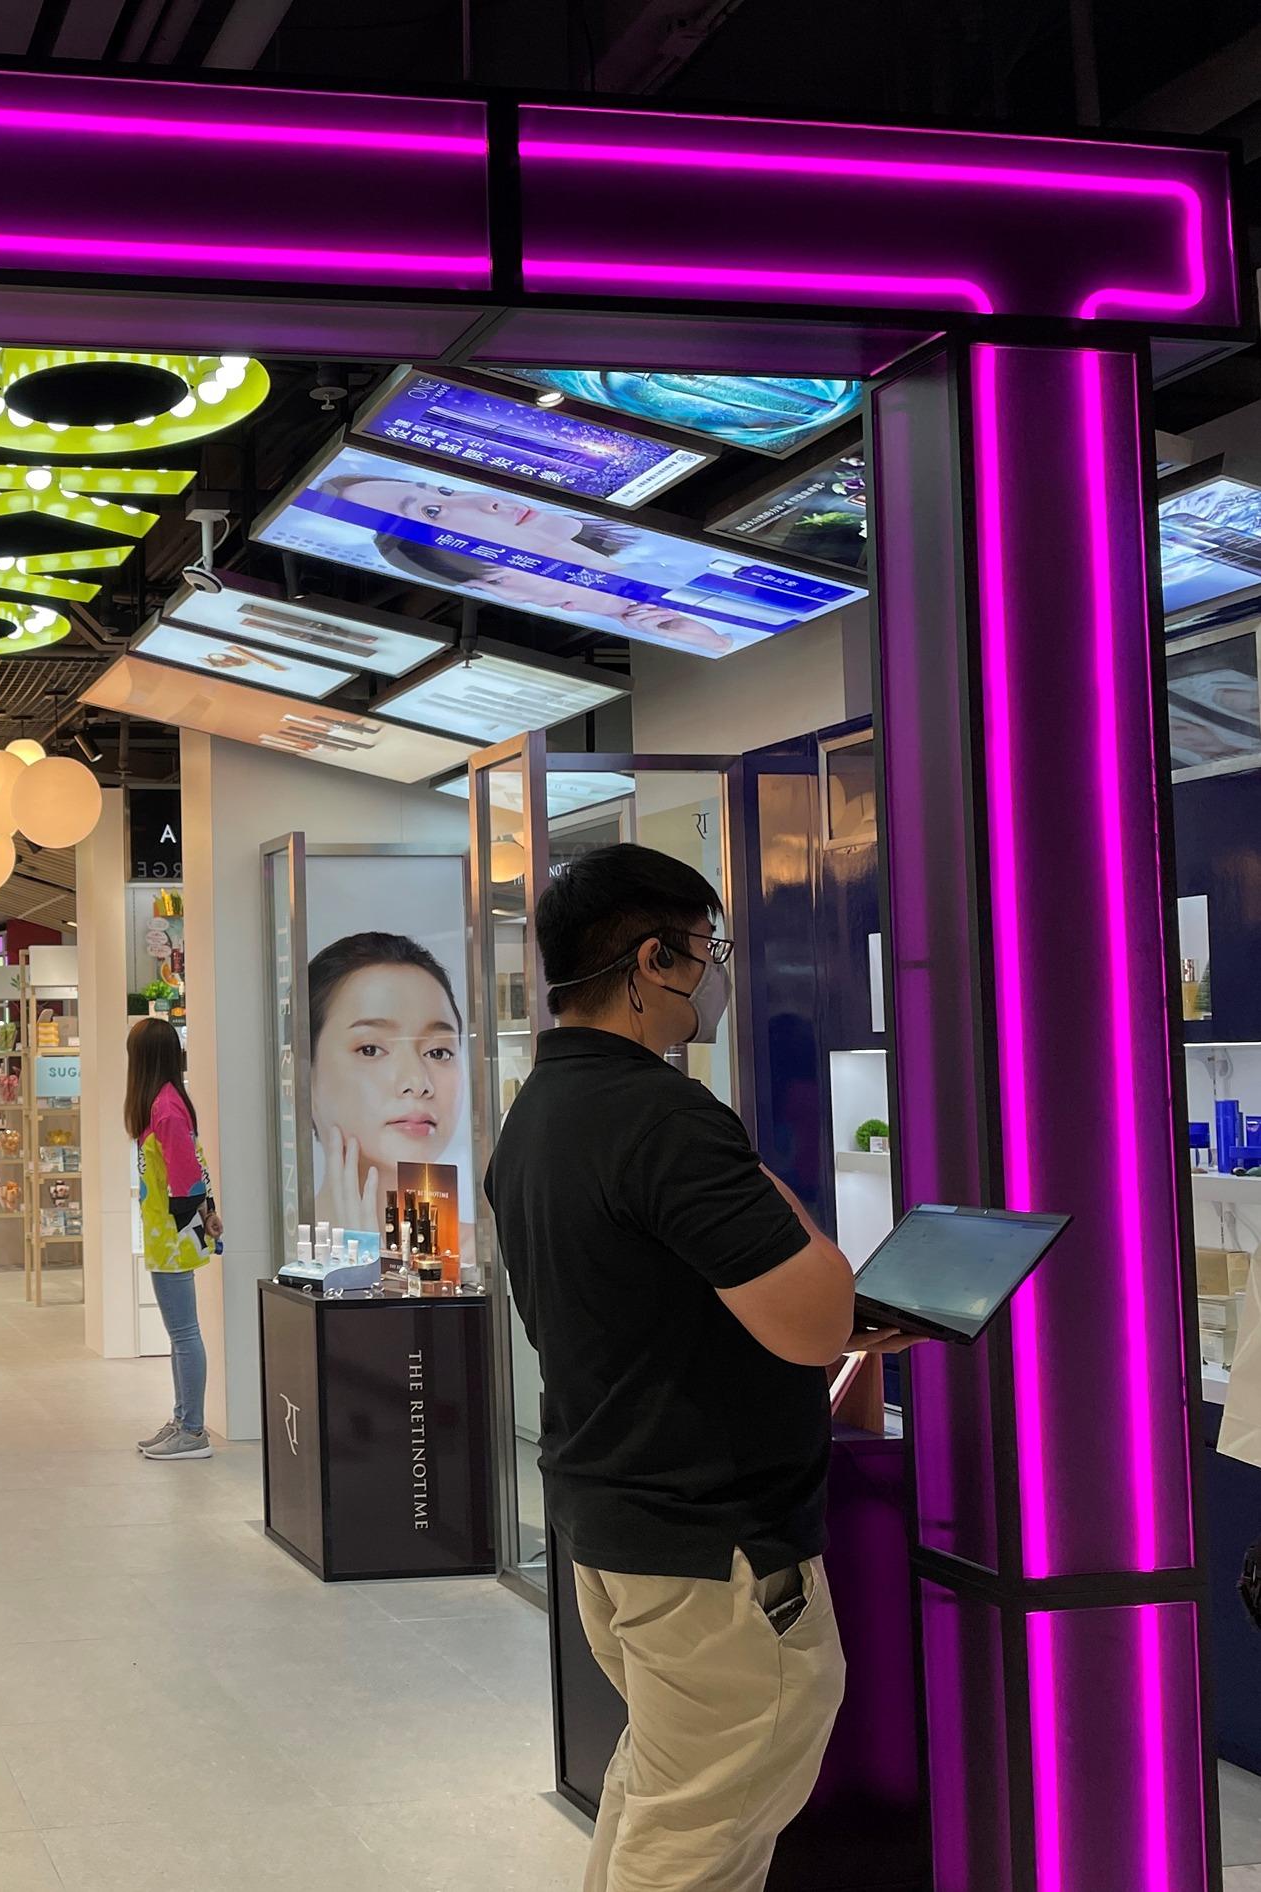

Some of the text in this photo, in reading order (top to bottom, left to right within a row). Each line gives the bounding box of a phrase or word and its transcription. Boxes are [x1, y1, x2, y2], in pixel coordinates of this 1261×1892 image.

[407, 377, 440, 400] ONE
[434, 533, 542, 569] 雪肌精
[49, 1066, 81, 1078] SUG
[408, 1350, 429, 1530] THE RETINOTIME
